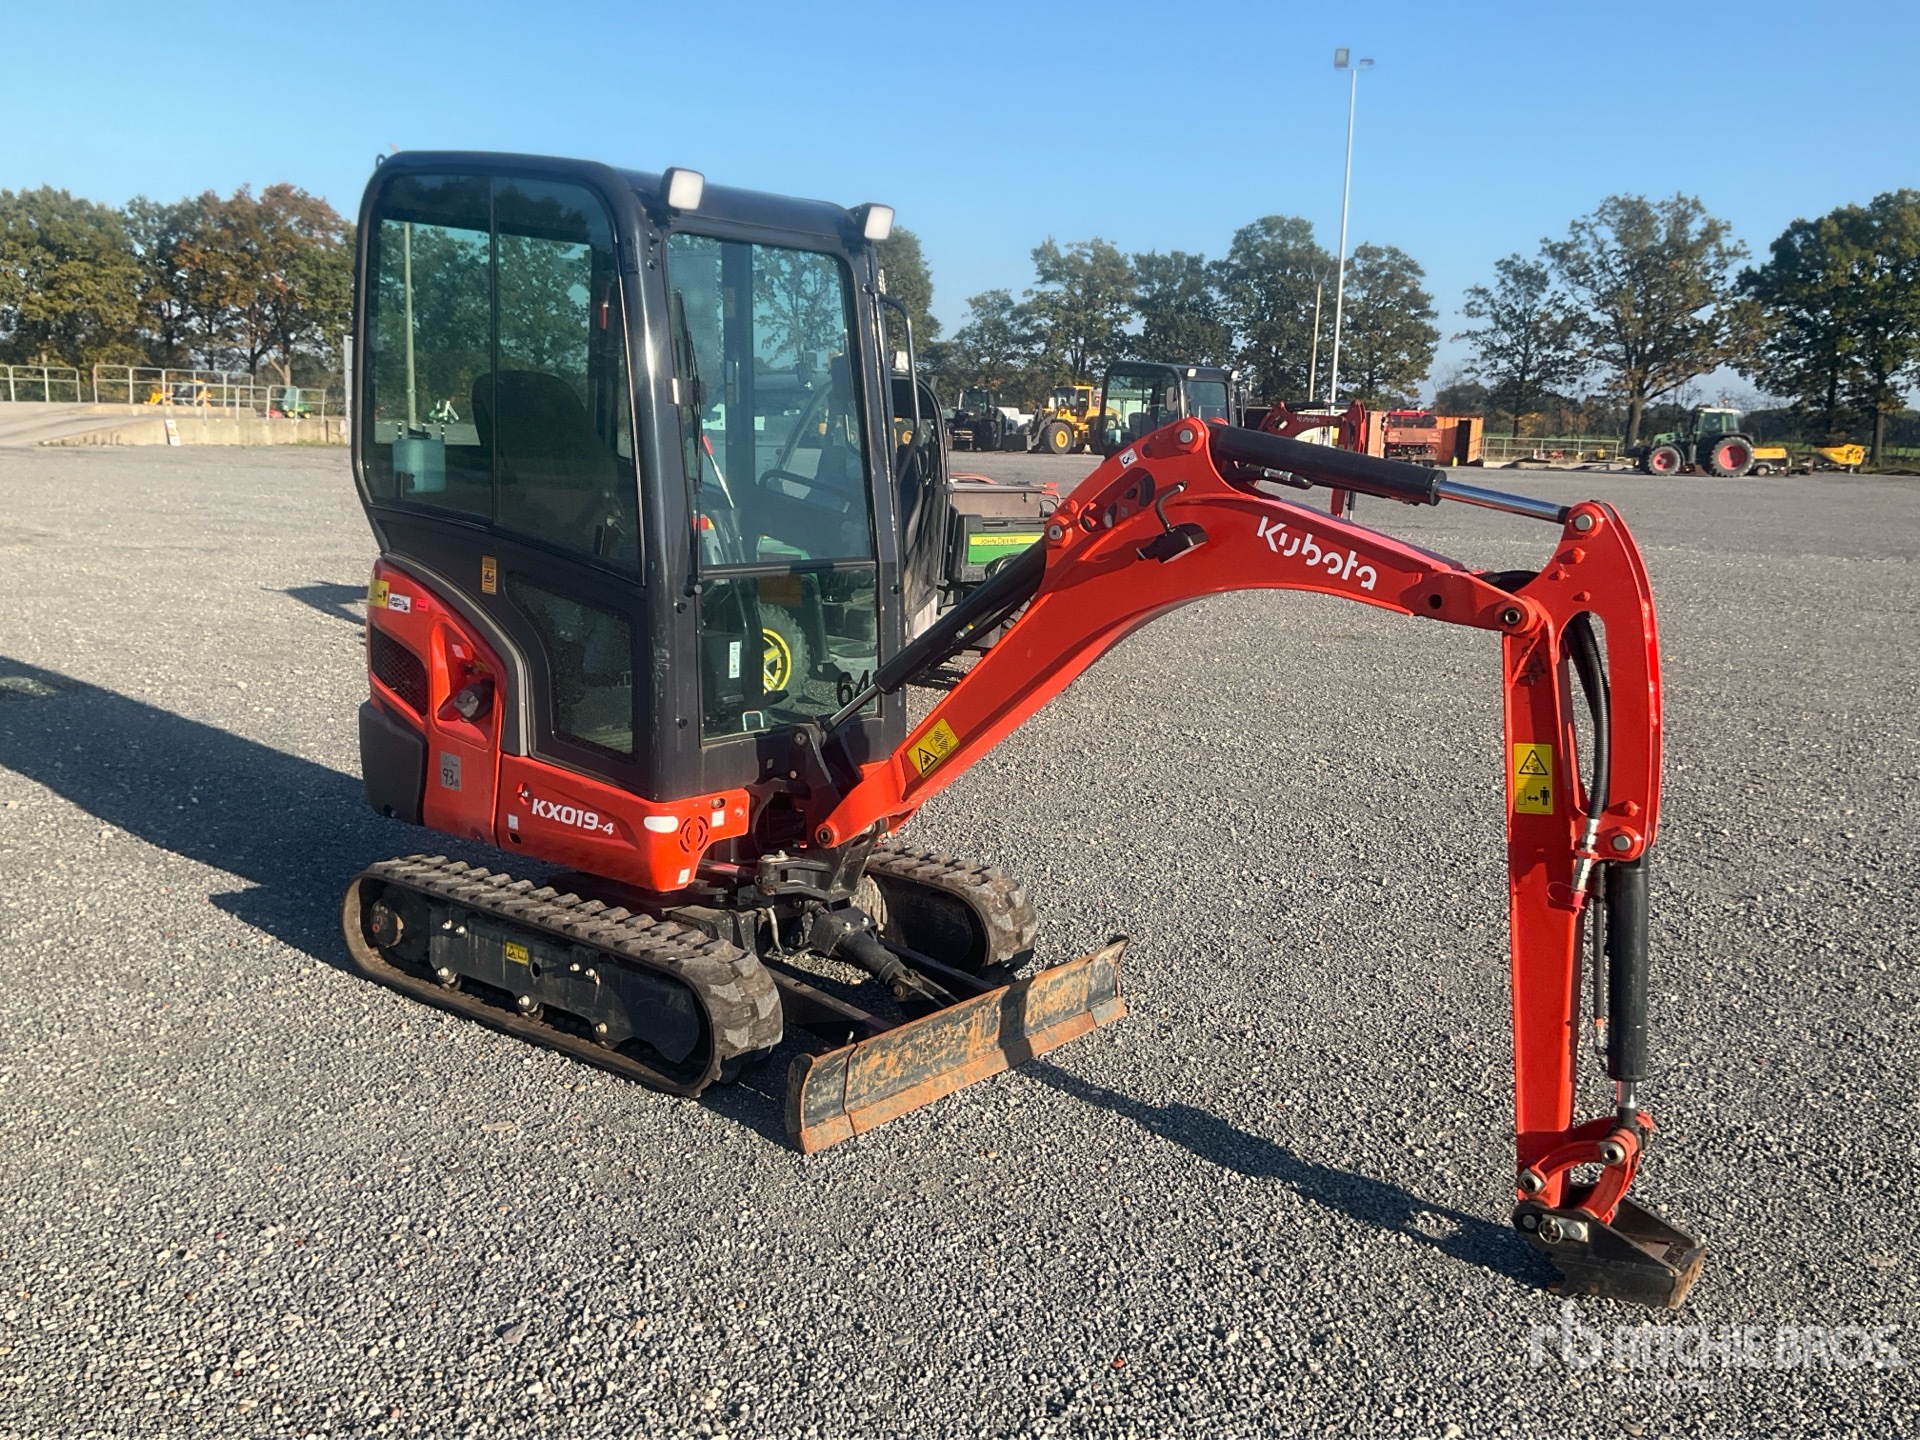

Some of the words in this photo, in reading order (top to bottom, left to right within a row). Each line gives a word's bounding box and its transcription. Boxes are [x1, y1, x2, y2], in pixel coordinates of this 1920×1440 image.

[980, 537, 997, 545] JOHN
[997, 537, 1018, 545] DEERE
[1256, 515, 1378, 591] Kubota
[531, 798, 615, 835] KX019-4
